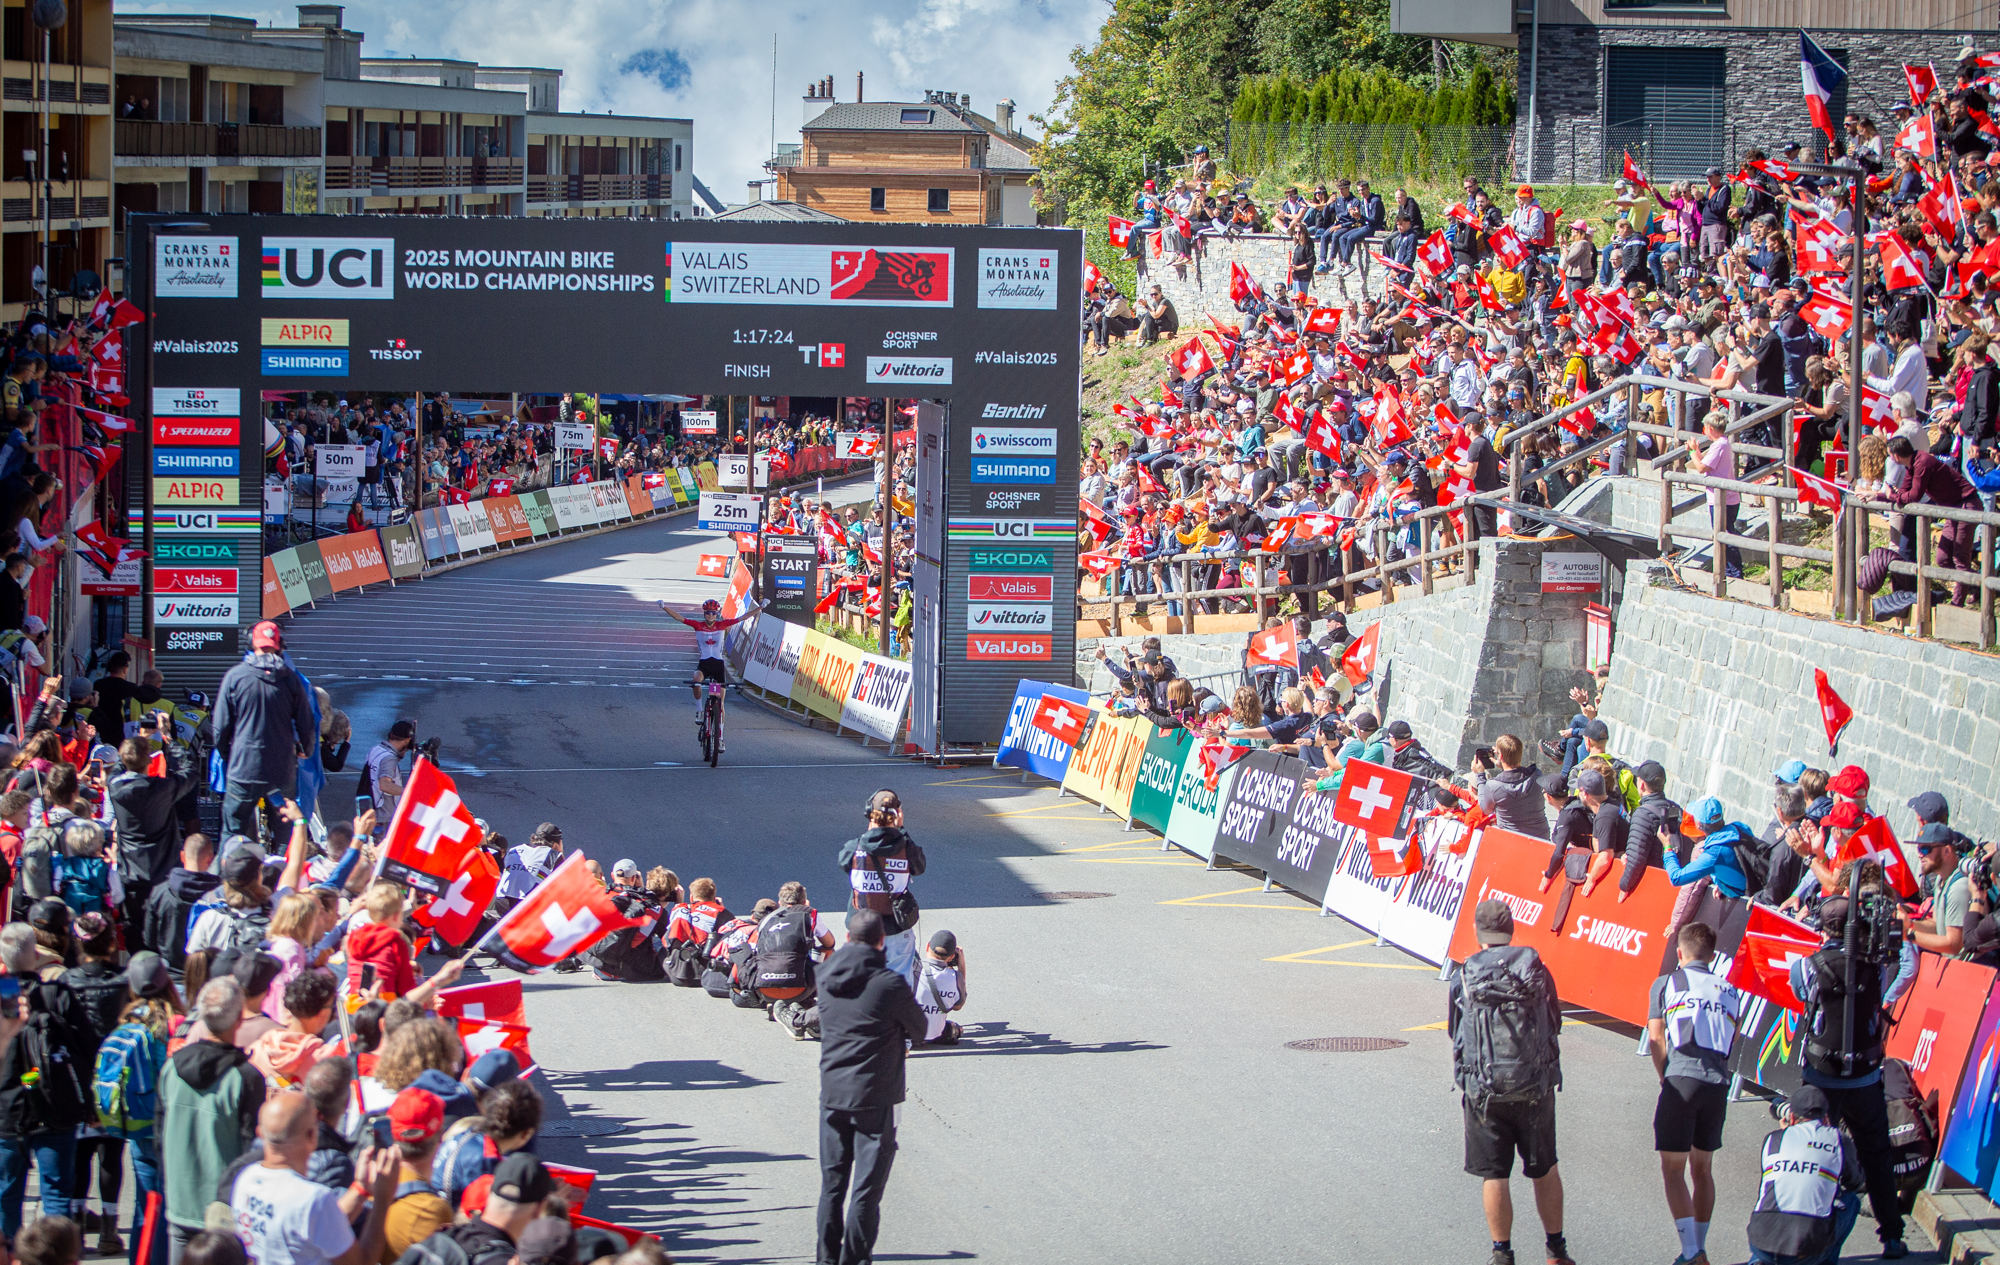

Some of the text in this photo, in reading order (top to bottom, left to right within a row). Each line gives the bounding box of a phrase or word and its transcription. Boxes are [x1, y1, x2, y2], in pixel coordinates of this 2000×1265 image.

[164, 245, 208, 255] CRANS
[164, 257, 230, 268] MONTANA
[404, 249, 615, 269] 2025 MOUNTAIN BIKE
[681, 252, 748, 270] VALAIS
[986, 256, 1029, 268] CRANS
[285, 248, 383, 288] UCI
[986, 269, 1050, 281] MONTANA
[167, 270, 225, 288] Absolutely
[404, 272, 655, 293] WORLD CHAMPIONSHIPS
[681, 275, 821, 296] SWITZERLAND
[988, 282, 1045, 301] Absolutely
[278, 324, 333, 343] ALPIQ
[733, 329, 794, 345] 1:17:24
[885, 330, 938, 341] OCHSNER
[153, 340, 239, 354] #Valais2025
[882, 340, 919, 349] SPORT
[369, 349, 422, 360] TISSOT
[975, 351, 1058, 365] #Valais2025
[268, 356, 342, 369] SHIMANO
[724, 364, 771, 378] FINISH
[892, 363, 945, 377] vittoria
[173, 400, 219, 409] TISSOT
[981, 403, 1048, 419] Santini
[686, 418, 710, 426] 100m
[169, 427, 232, 436] SPECIALIZED
[562, 429, 584, 440] 75m
[990, 434, 1052, 447] swisscom
[157, 455, 234, 467] SHIMANO
[325, 453, 354, 465] 50m
[976, 464, 1051, 477] SHIMANO
[167, 482, 224, 501] ALPIQ
[329, 484, 354, 492] RANS
[989, 491, 1041, 501] OCHSNER
[713, 504, 748, 518] 25m
[986, 500, 1021, 509] SPORT
[177, 514, 213, 528] UCI
[708, 521, 752, 531] SHIMANO
[994, 522, 1030, 537] UCI
[116, 563, 139, 571] OBUS
[324, 546, 383, 575] ValJob ValJob
[770, 558, 811, 571] START
[1562, 563, 1599, 571] AUTOBUS
[185, 574, 222, 586] Valais
[1001, 581, 1037, 594] Valais
[176, 604, 232, 617] vittoria
[992, 610, 1047, 624] vittoria
[170, 631, 224, 641] OCHSNER
[167, 640, 204, 650] SPORT
[974, 640, 1045, 654] ValJob
[812, 652, 855, 714] ALPIQ
[866, 663, 910, 712] TISSOT
[1070, 721, 1146, 808] ALPIQ ALPIQ
[1236, 766, 1296, 814] OCHSNER
[1221, 802, 1265, 844] SPORT
[1276, 825, 1321, 871] SPORT
[511, 863, 537, 873] STAFF
[889, 860, 907, 869] UCI
[863, 871, 895, 882] VIDO
[1347, 839, 1464, 921] vitto vittoria
[862, 882, 894, 892] RADO
[1570, 914, 1648, 956] S-WORKS
[940, 990, 957, 999] UCI
[1718, 984, 1738, 1000] UCI
[1686, 997, 1727, 1016] STAFF
[1911, 1028, 1938, 1073] RTS
[1813, 1141, 1837, 1155] UCI
[1772, 1160, 1819, 1176] STAFF
